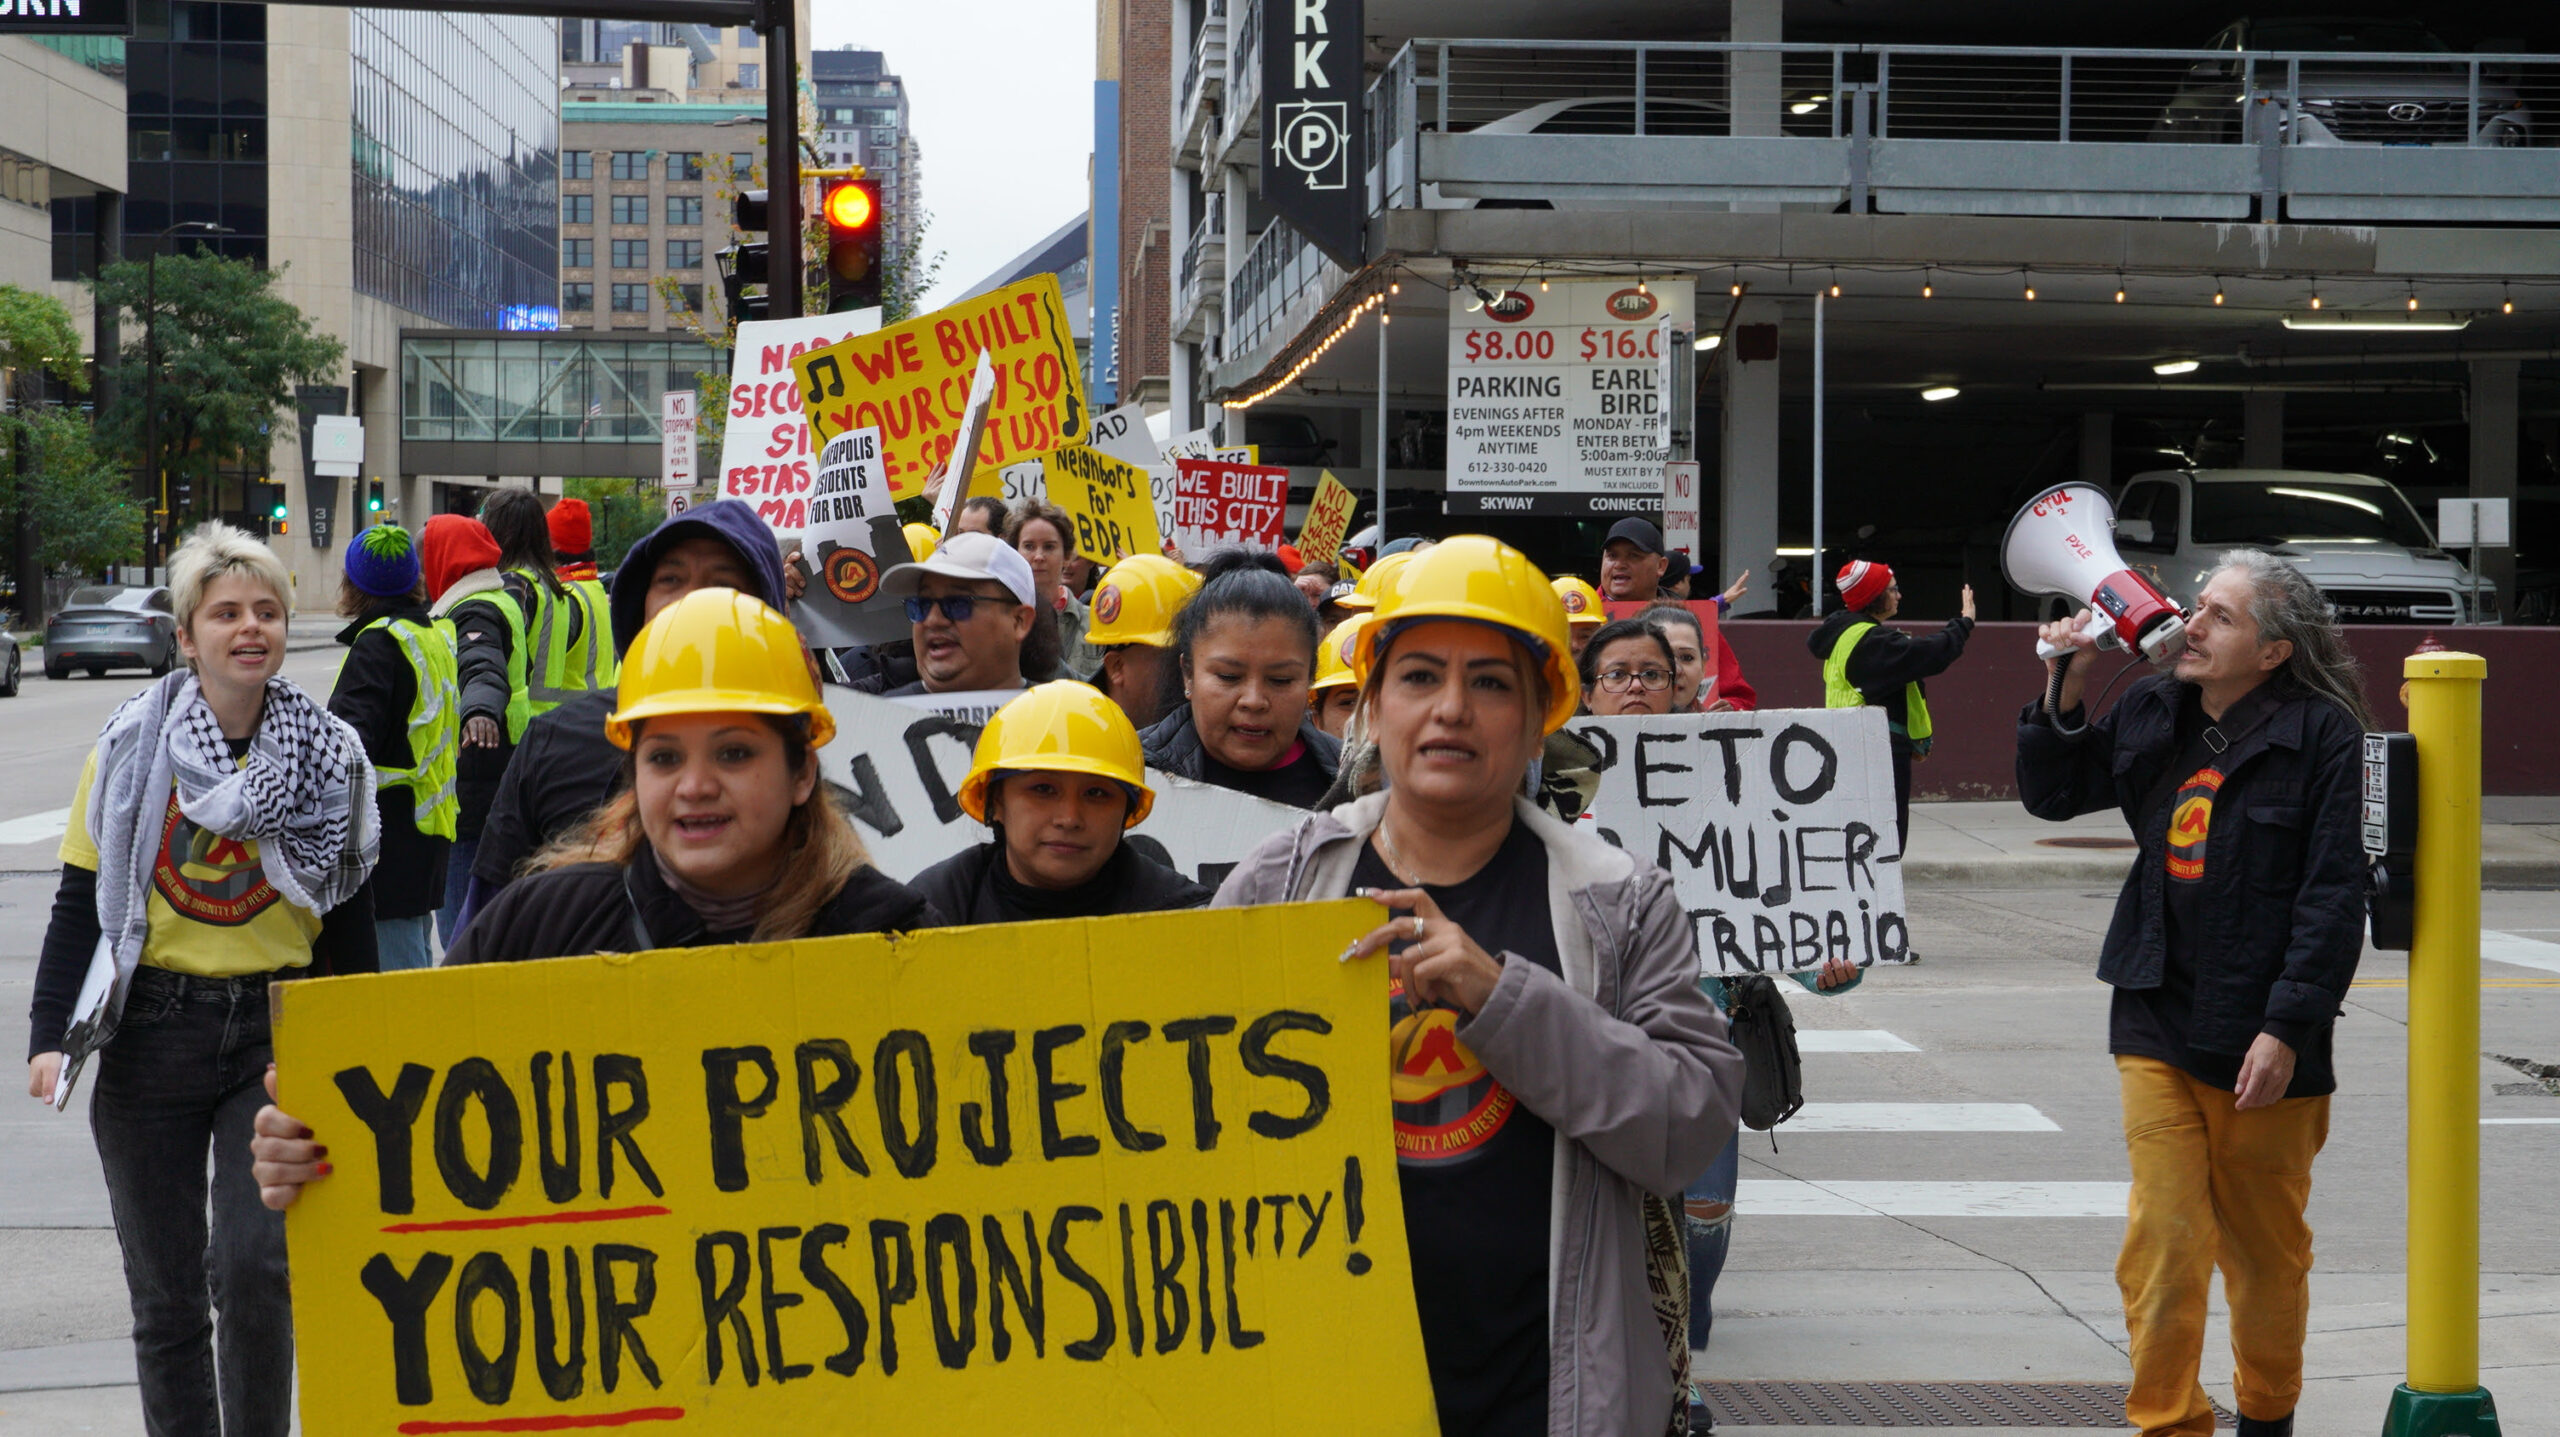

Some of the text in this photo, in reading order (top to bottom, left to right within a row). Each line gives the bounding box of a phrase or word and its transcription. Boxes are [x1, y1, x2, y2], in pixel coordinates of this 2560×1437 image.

[851, 332, 924, 385] WE
[934, 292, 1044, 368] BUILT
[1465, 329, 1554, 364] $8.00
[1457, 376, 1561, 398] PARKING
[1592, 369, 1659, 390] EARL
[672, 398, 686, 415] NO
[731, 381, 806, 418] SECO
[830, 386, 941, 449] YOUR
[1014, 351, 1061, 402] SO
[665, 418, 694, 433] STOPPING
[1453, 407, 1564, 420] EVENINGS AFTER
[1574, 418, 1632, 430] MONDAY
[1009, 403, 1060, 453] US!
[1456, 425, 1561, 440] 4pm WEEKENDS
[765, 423, 815, 459] SI
[1478, 442, 1538, 454] ANYTIME
[1577, 436, 1618, 447] ENTER
[726, 460, 811, 497] ESTAS
[1056, 448, 1136, 498] Neighbors
[1468, 462, 1547, 473] 612-330-0420
[1585, 467, 1612, 477] MUST
[1616, 467, 1638, 477] EXIT
[1641, 467, 1653, 477] BY
[1177, 470, 1286, 503] WE BUILT
[1458, 478, 1557, 487] DowntownAutoPark.com
[1620, 482, 1659, 490] INCLUDED
[1675, 473, 1690, 498] NO
[1324, 481, 1347, 512] NO
[1480, 497, 1534, 510] SKYWAY
[2033, 489, 2073, 517] CTUL
[757, 496, 813, 529] MA
[810, 495, 865, 525] FOR BDR
[1176, 496, 1219, 525] THIS
[1226, 502, 1280, 533] CITY
[1313, 498, 1346, 538] MORE
[1667, 511, 1697, 530] STOPPING
[2065, 534, 2094, 559] PYLE
[1331, 583, 1356, 597] CAT
[2338, 604, 2409, 617] RAM
[334, 1010, 1332, 1214] YOUR PROJECTS
[1442, 1127, 1470, 1151] AND
[360, 1155, 1373, 1405] YOUR RESPONSIBILITY!
